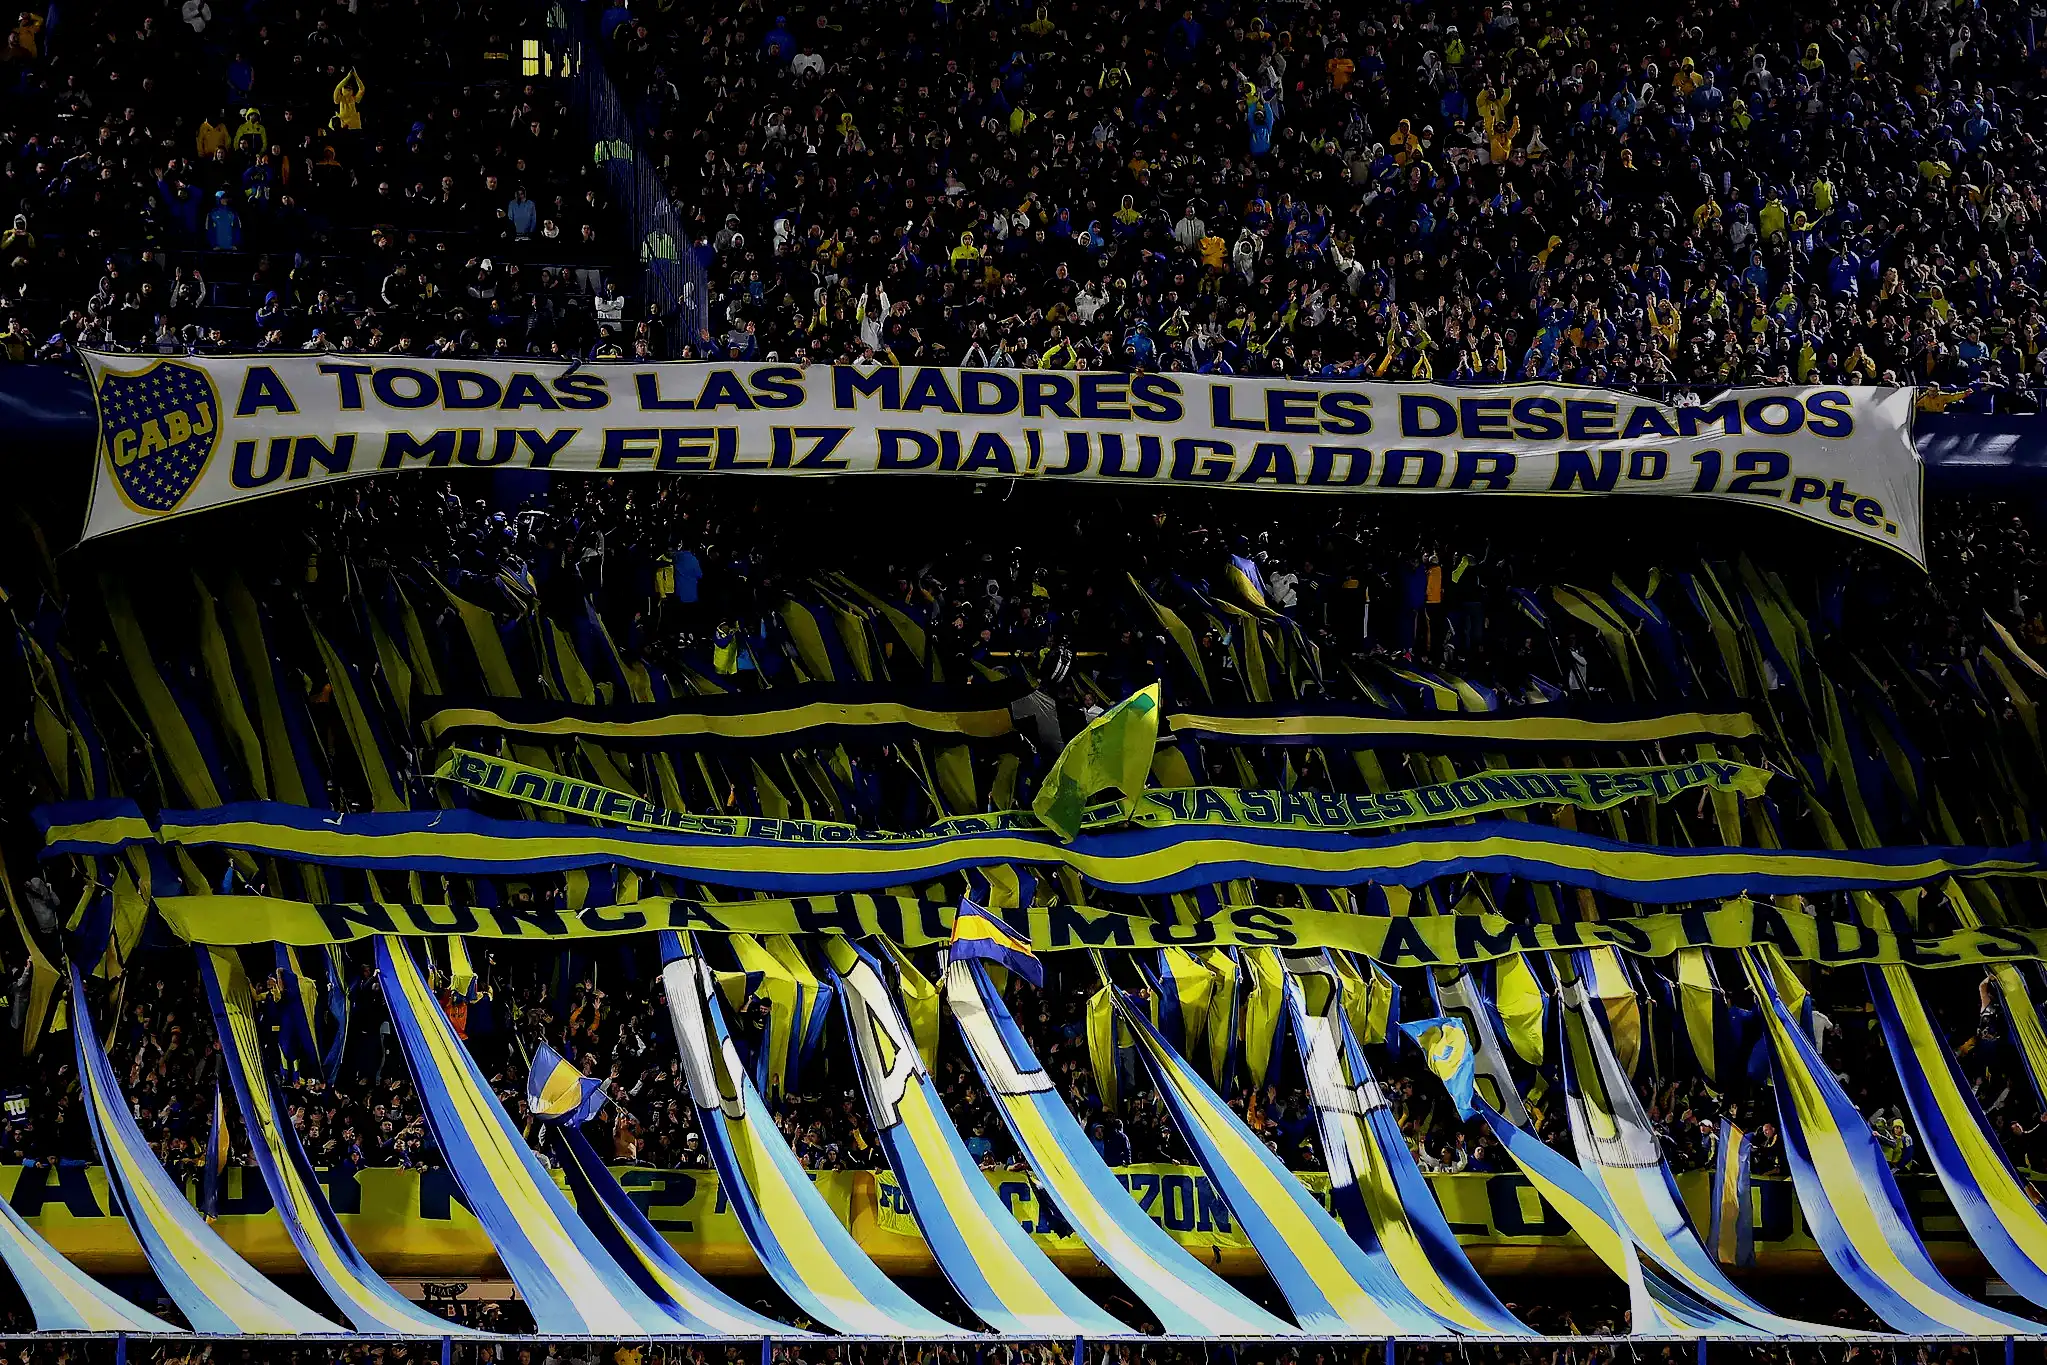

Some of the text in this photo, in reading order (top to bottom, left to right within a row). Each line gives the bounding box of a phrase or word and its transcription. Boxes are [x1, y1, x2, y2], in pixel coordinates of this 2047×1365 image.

[114, 402, 213, 467] CABJ
[235, 364, 1854, 441] A TODAS LAS MADRES LES DESEAMOS
[230, 433, 357, 490] UN
[379, 427, 583, 470] MUY
[598, 425, 853, 471] FELIZ
[1690, 450, 1791, 498] 12
[1145, 788, 1239, 821] YA
[1233, 788, 1415, 826] SABES
[1416, 773, 1582, 816] DONDE
[315, 900, 728, 940] NUNCA
[1379, 898, 2040, 965] AMISTADES
